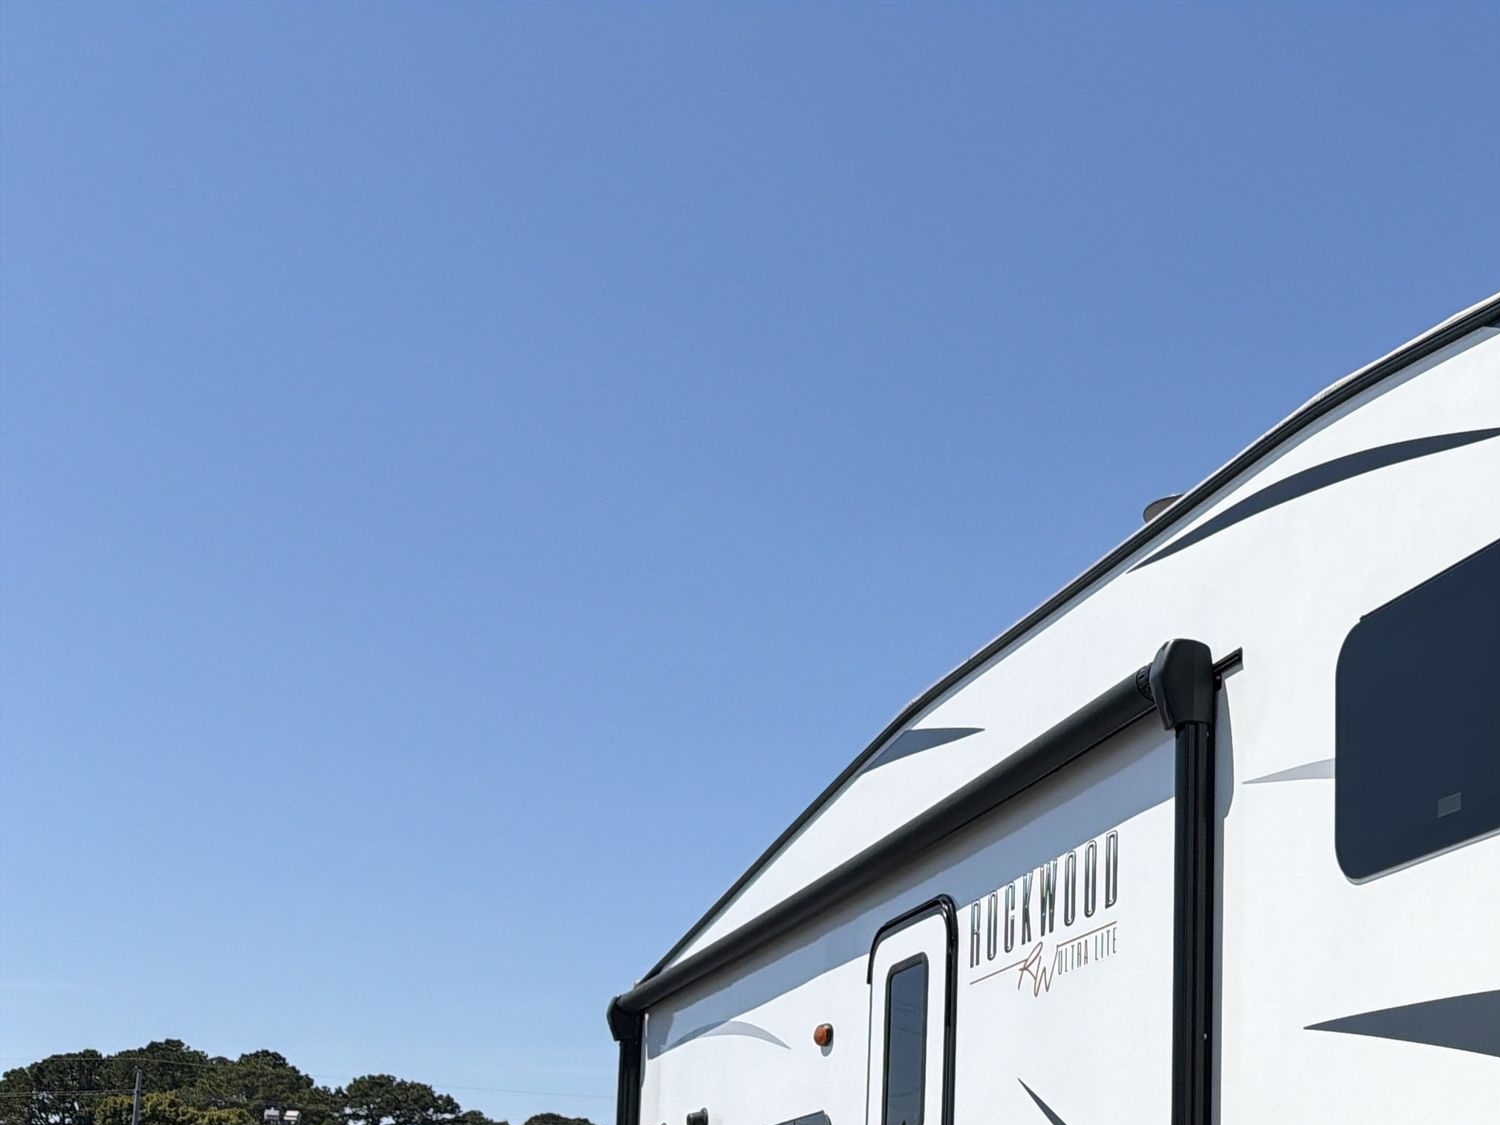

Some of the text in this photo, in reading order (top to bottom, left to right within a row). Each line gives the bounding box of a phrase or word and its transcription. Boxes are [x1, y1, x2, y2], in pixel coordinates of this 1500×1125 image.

[970, 829, 1118, 969] ROCKWOOD
[1058, 939, 1088, 976] ULTRA
[1095, 927, 1117, 961] LITE
